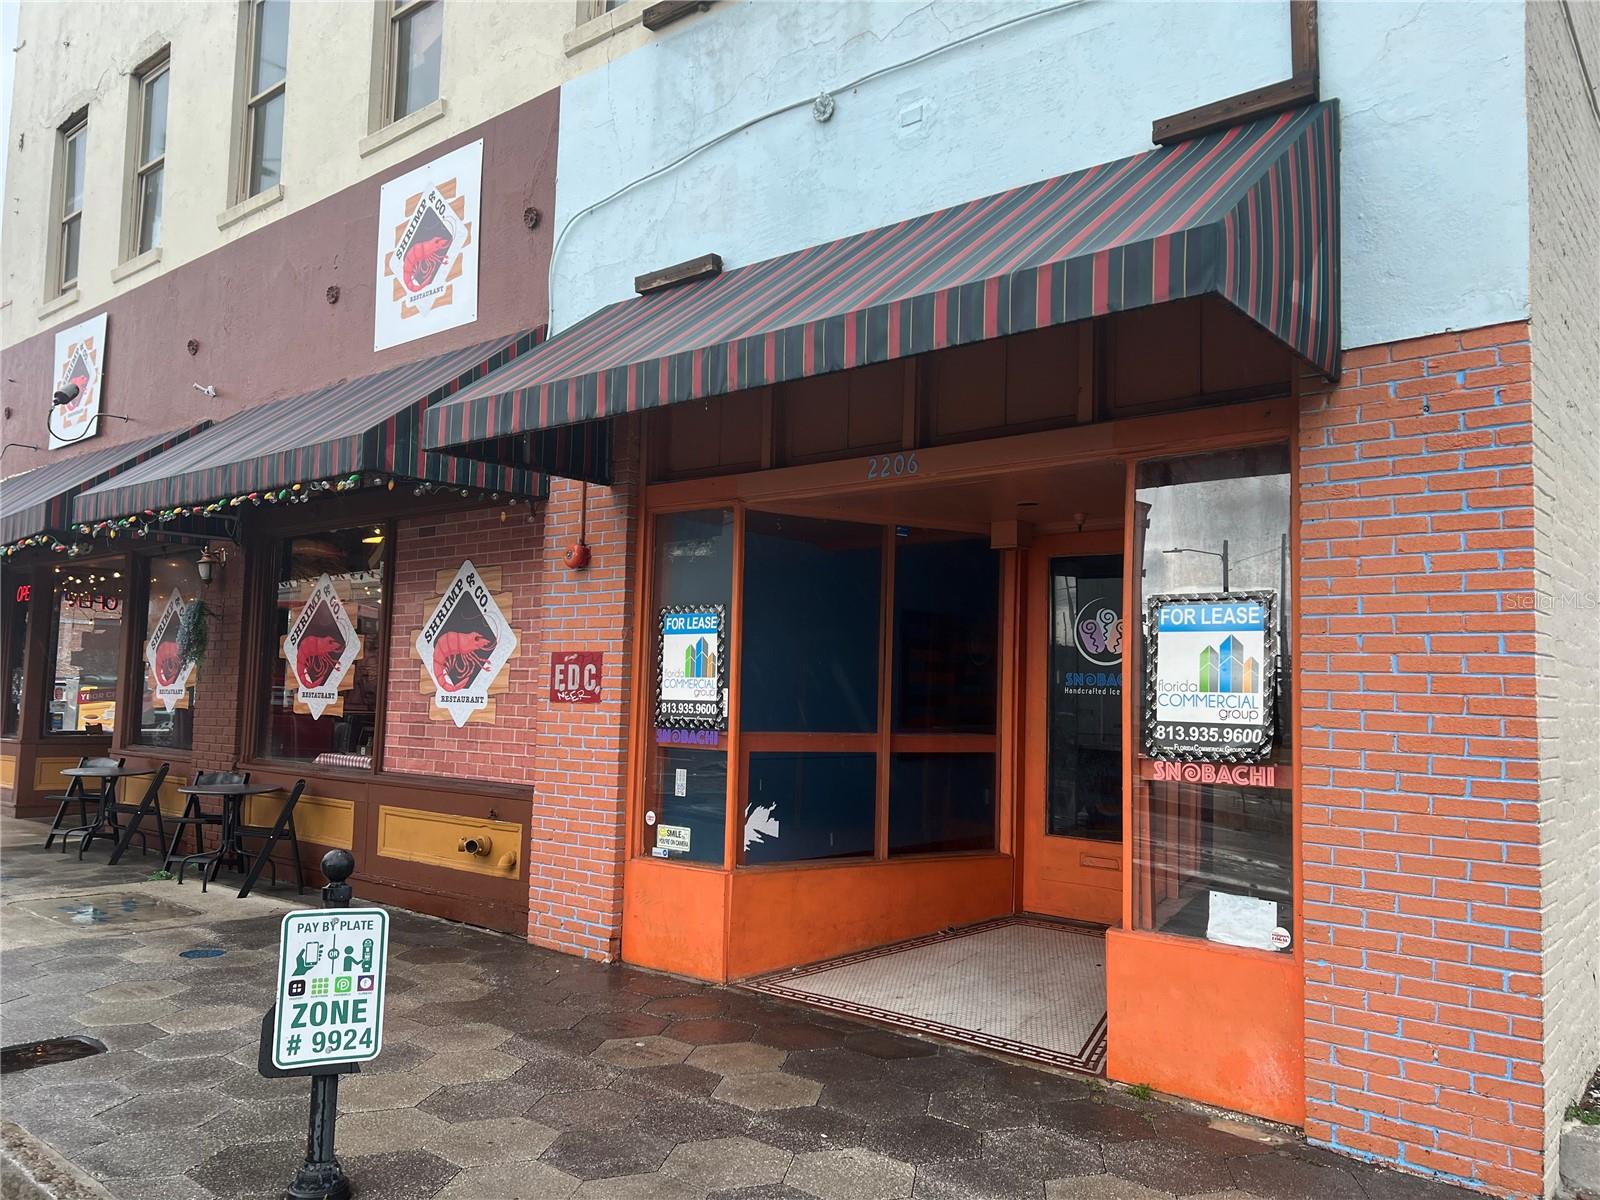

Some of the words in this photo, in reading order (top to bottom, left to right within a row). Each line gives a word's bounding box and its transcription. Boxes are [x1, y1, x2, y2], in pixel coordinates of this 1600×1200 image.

[396, 198, 427, 260] SHRIMP
[428, 190, 436, 203] &
[434, 199, 446, 219] CO.
[409, 286, 445, 302] RESTAURANT
[868, 452, 918, 480] 2206
[290, 589, 323, 646] SHRIMP
[323, 583, 331, 596] &
[329, 596, 341, 619] CO.
[424, 579, 464, 643] SHRIMP
[466, 573, 476, 587] &
[474, 586, 489, 613] CO.
[1160, 608, 1196, 625] FOR
[1201, 607, 1260, 625] LEASE
[151, 601, 174, 650] SHRIMP
[666, 617, 685, 631] FOR
[687, 616, 718, 630] LEASE
[664, 678, 716, 689] COMMERCIAL
[1065, 687, 1107, 695] Handcrafted
[1158, 680, 1198, 692] florida
[301, 691, 336, 700] RESTAURANT
[440, 695, 485, 704] RESTAURANT
[693, 689, 716, 698] group
[1158, 693, 1259, 710] COMMERCIAL
[661, 702, 718, 715] 813.935.9600
[1218, 709, 1259, 720] group
[656, 728, 719, 746] SNOBACHI
[1156, 725, 1263, 743] 813.935.9600
[1153, 760, 1275, 787] SNOBACHI
[666, 829, 682, 839] SMILE
[297, 922, 319, 934] PAY
[322, 921, 336, 932] BY
[340, 920, 374, 931] PLATE
[290, 998, 368, 1029] ZONE
[286, 1033, 302, 1056] #
[311, 1027, 373, 1054] 9924
